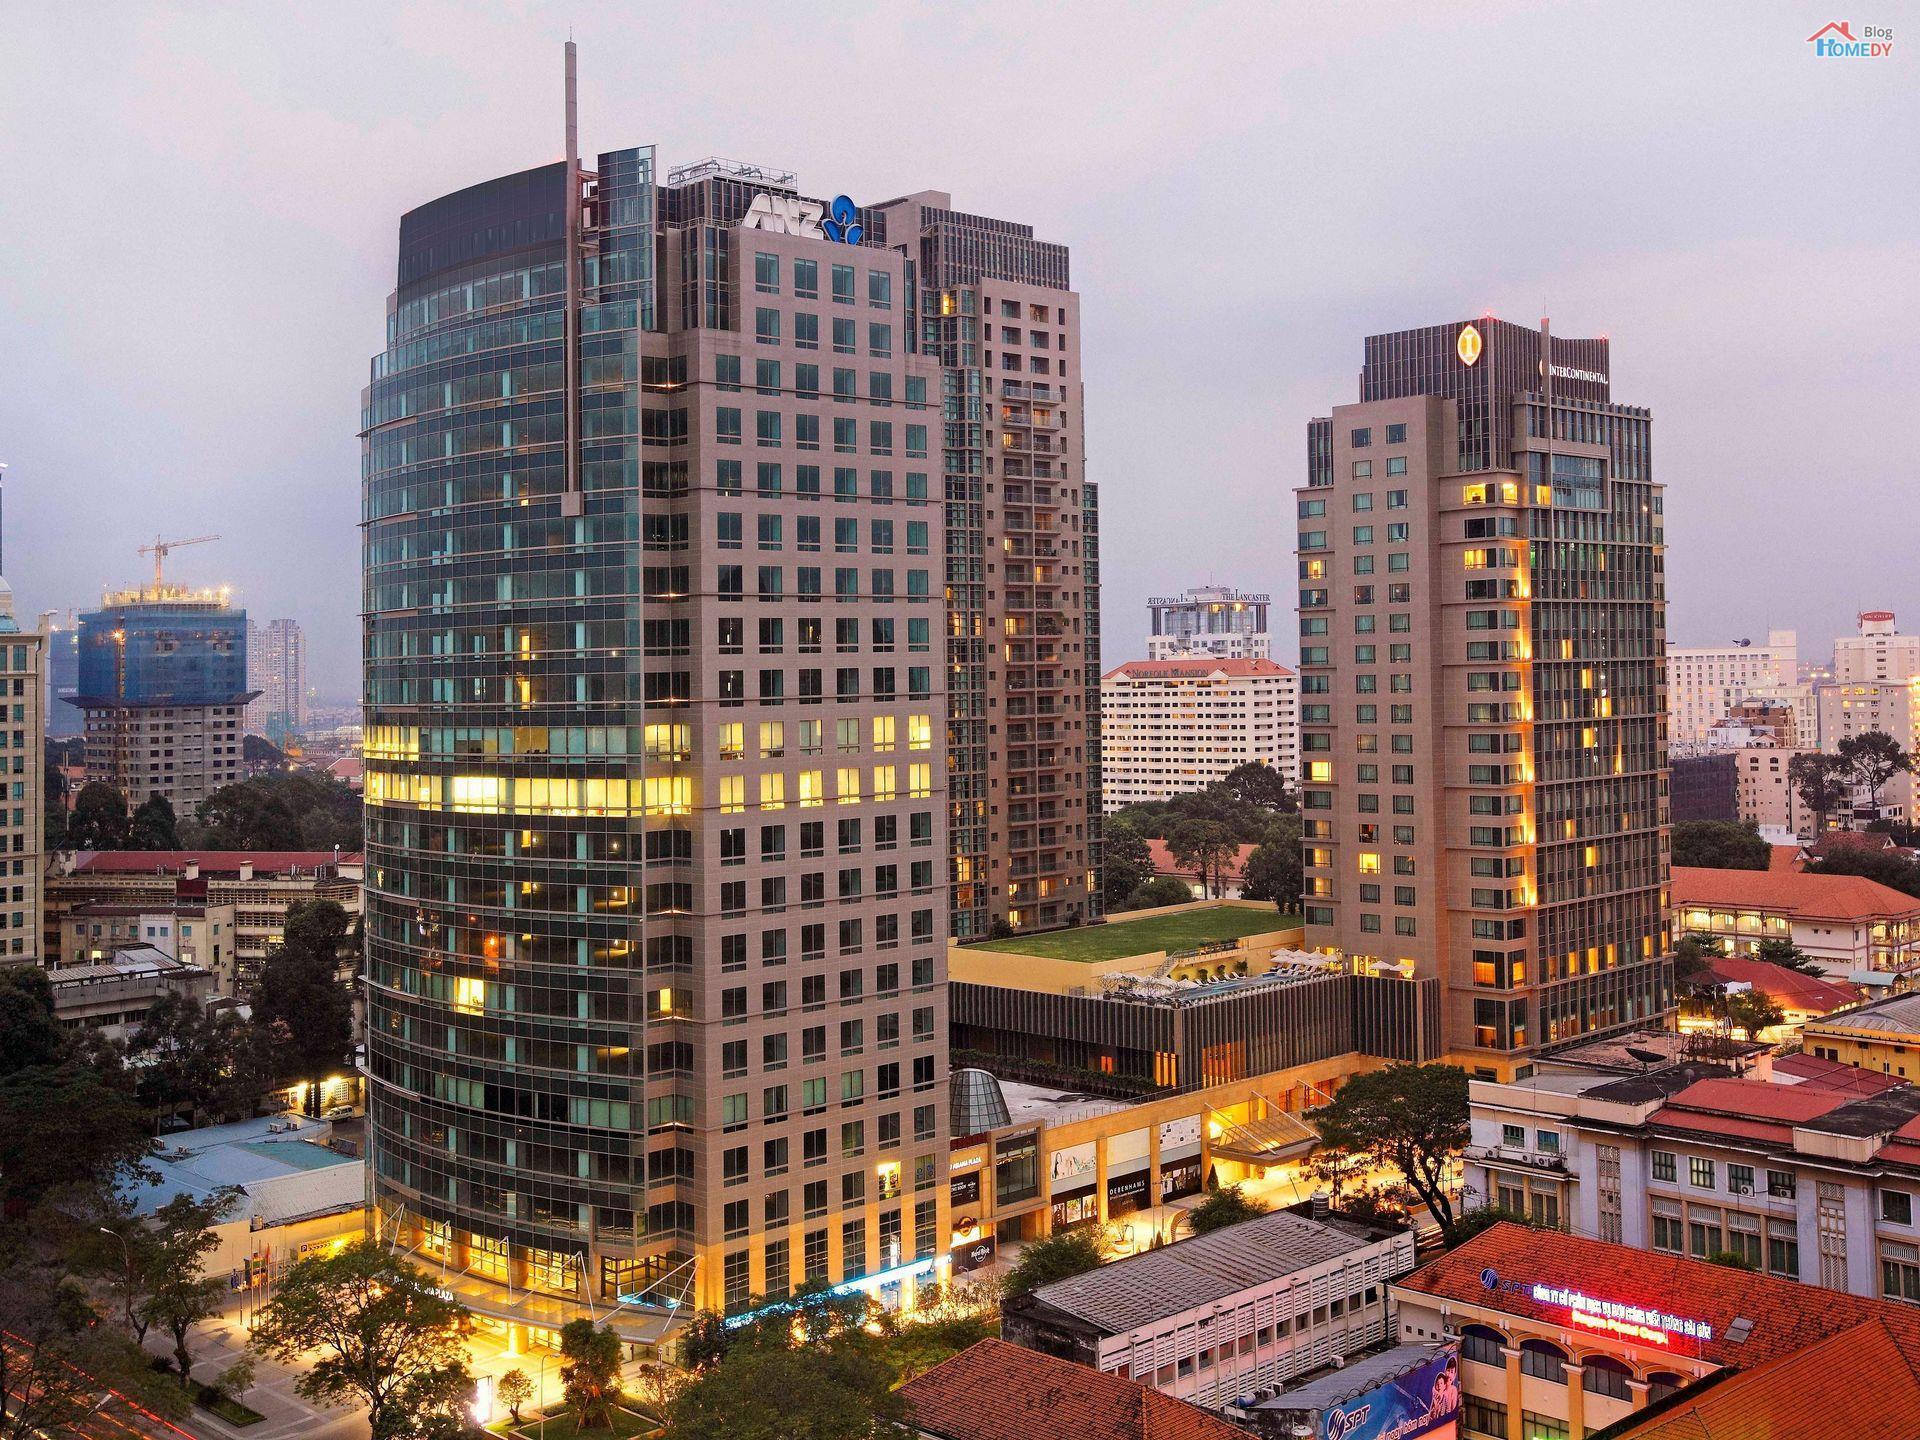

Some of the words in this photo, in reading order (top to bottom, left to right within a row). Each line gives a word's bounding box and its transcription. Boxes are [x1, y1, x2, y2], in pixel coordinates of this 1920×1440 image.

[742, 193, 824, 241] ANZ
[1221, 593, 1234, 601] THE
[1235, 588, 1271, 602] LANCASTER
[1132, 668, 1168, 678] NORFOLK
[1171, 667, 1209, 678] MANSION
[1109, 1180, 1145, 1196] DEBENHAMS
[1344, 1404, 1371, 1432] SPT
